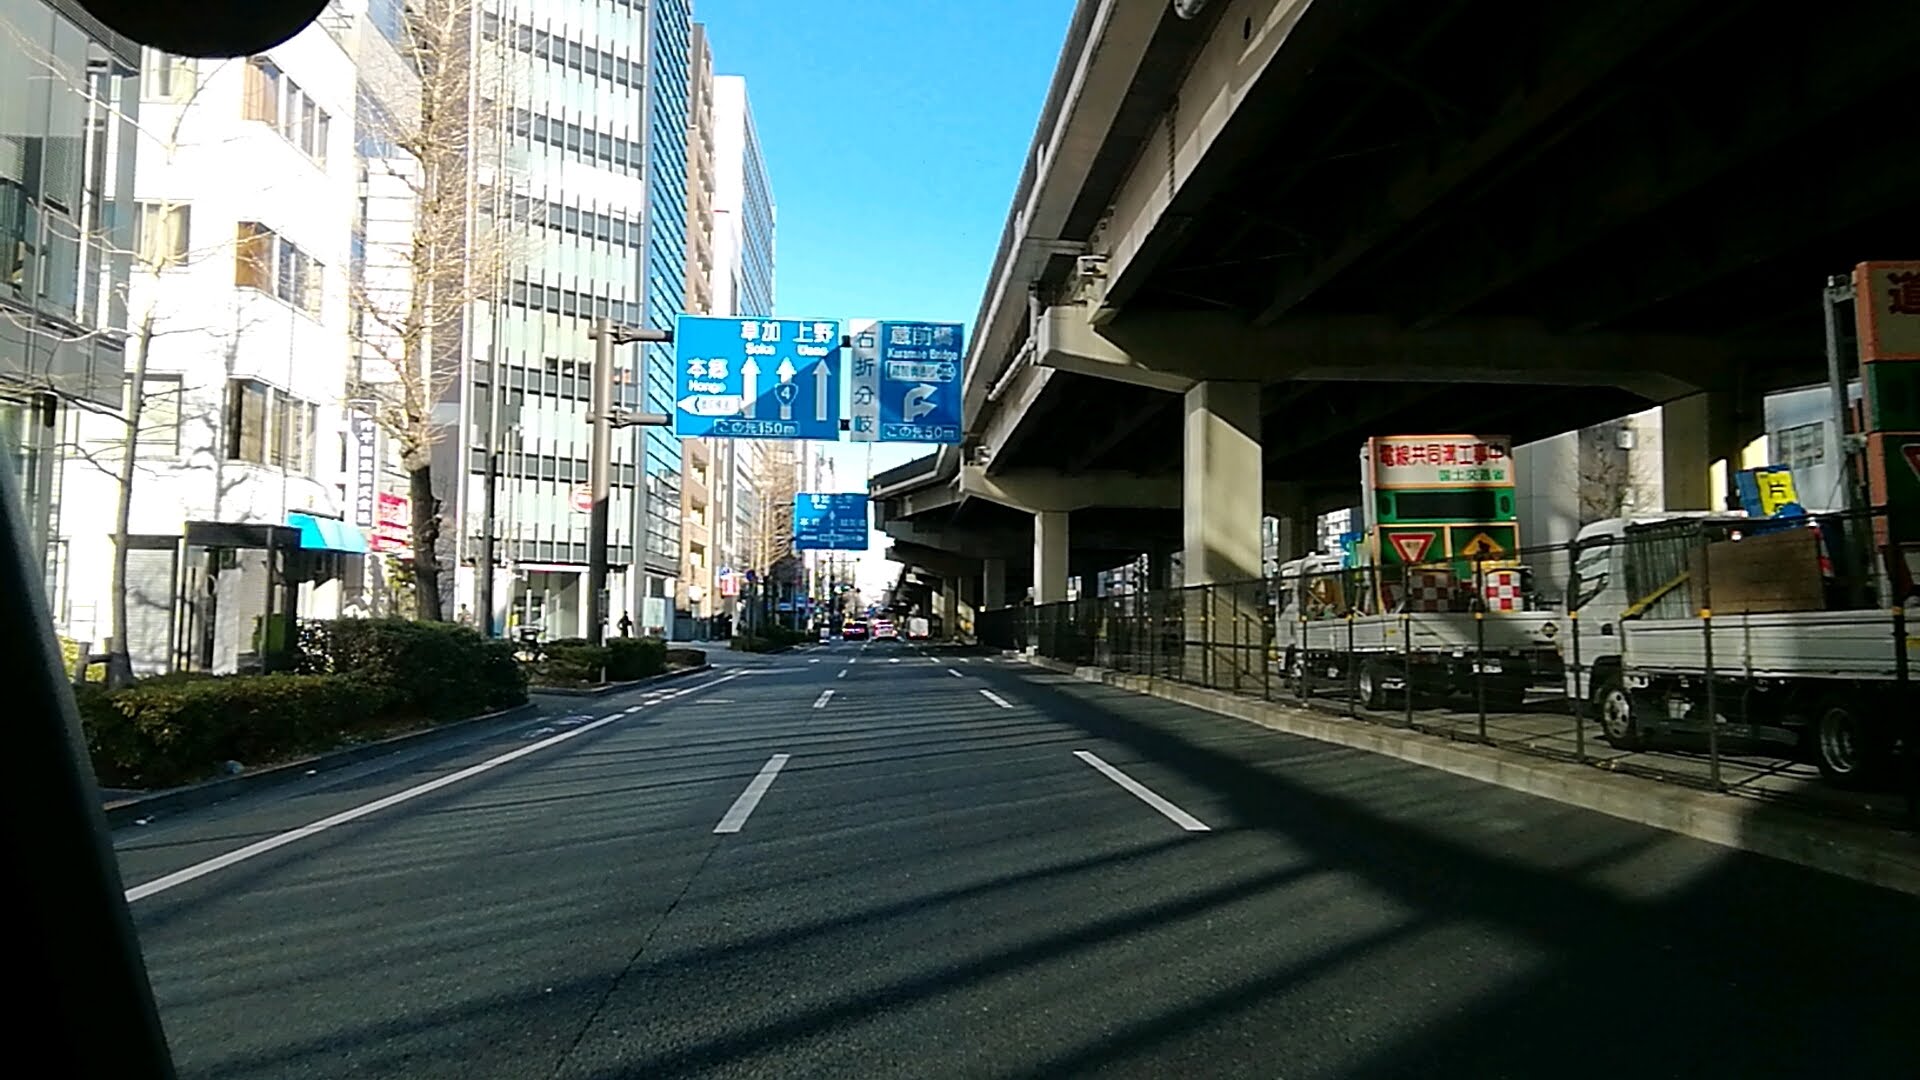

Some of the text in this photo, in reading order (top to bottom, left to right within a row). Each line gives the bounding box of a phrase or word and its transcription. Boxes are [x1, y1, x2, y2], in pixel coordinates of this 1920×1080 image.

[740, 321, 781, 342] 草加
[792, 322, 835, 343] 上野
[890, 326, 954, 346] 蔵前橋
[929, 349, 958, 361] Bridge
[687, 358, 729, 379] 本郷
[688, 380, 727, 394] Hongo
[854, 331, 875, 433] 右折分岐
[780, 386, 791, 400] 4
[719, 422, 796, 436] この先150m
[886, 426, 955, 439] この先50m
[1438, 469, 1505, 482] 国土交通省
